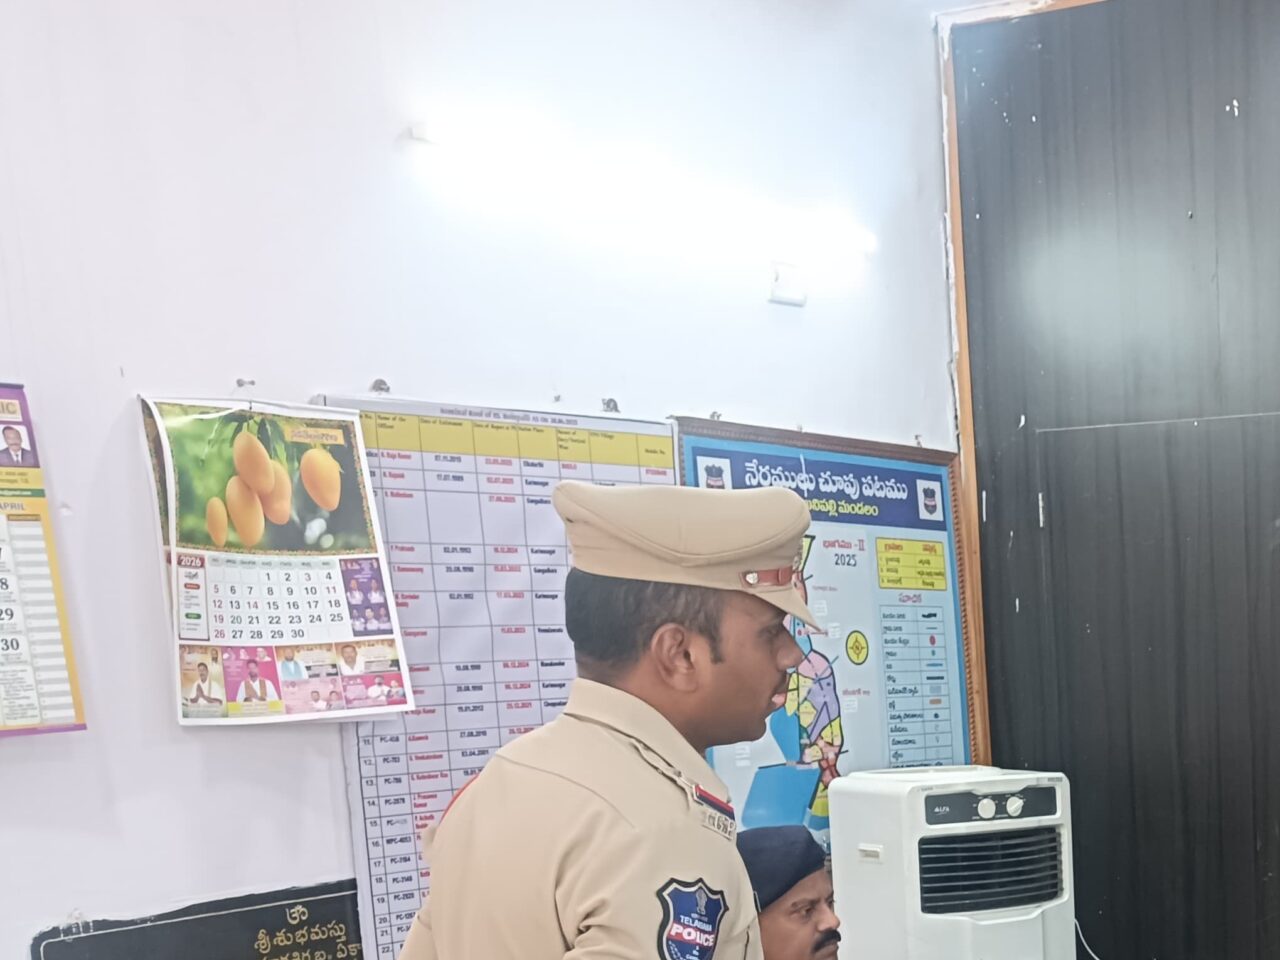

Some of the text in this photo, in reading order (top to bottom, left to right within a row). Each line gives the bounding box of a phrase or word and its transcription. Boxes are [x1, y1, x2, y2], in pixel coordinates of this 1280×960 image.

[818, 471, 860, 500] చూపు
[862, 475, 908, 500] పటము
[839, 502, 879, 516] మండలం
[180, 556, 202, 568] 2026
[834, 554, 858, 568] 2025
[265, 571, 332, 582] 1 2 3 4
[0, 577, 9, 591] 8
[213, 584, 337, 596] 5 6 7 8 9 10 11
[212, 599, 341, 610] 12 13 14 15 16 17 18
[213, 613, 344, 625] 19 20 21 22 23 24 25
[214, 629, 305, 640] 26 27 28 29 30
[1, 638, 20, 651] 30
[378, 916, 390, 924] 20.
[254, 920, 347, 954] శ్రీ శుభమస్తు
[669, 923, 715, 947] POLICE
[381, 946, 393, 954] 22.
